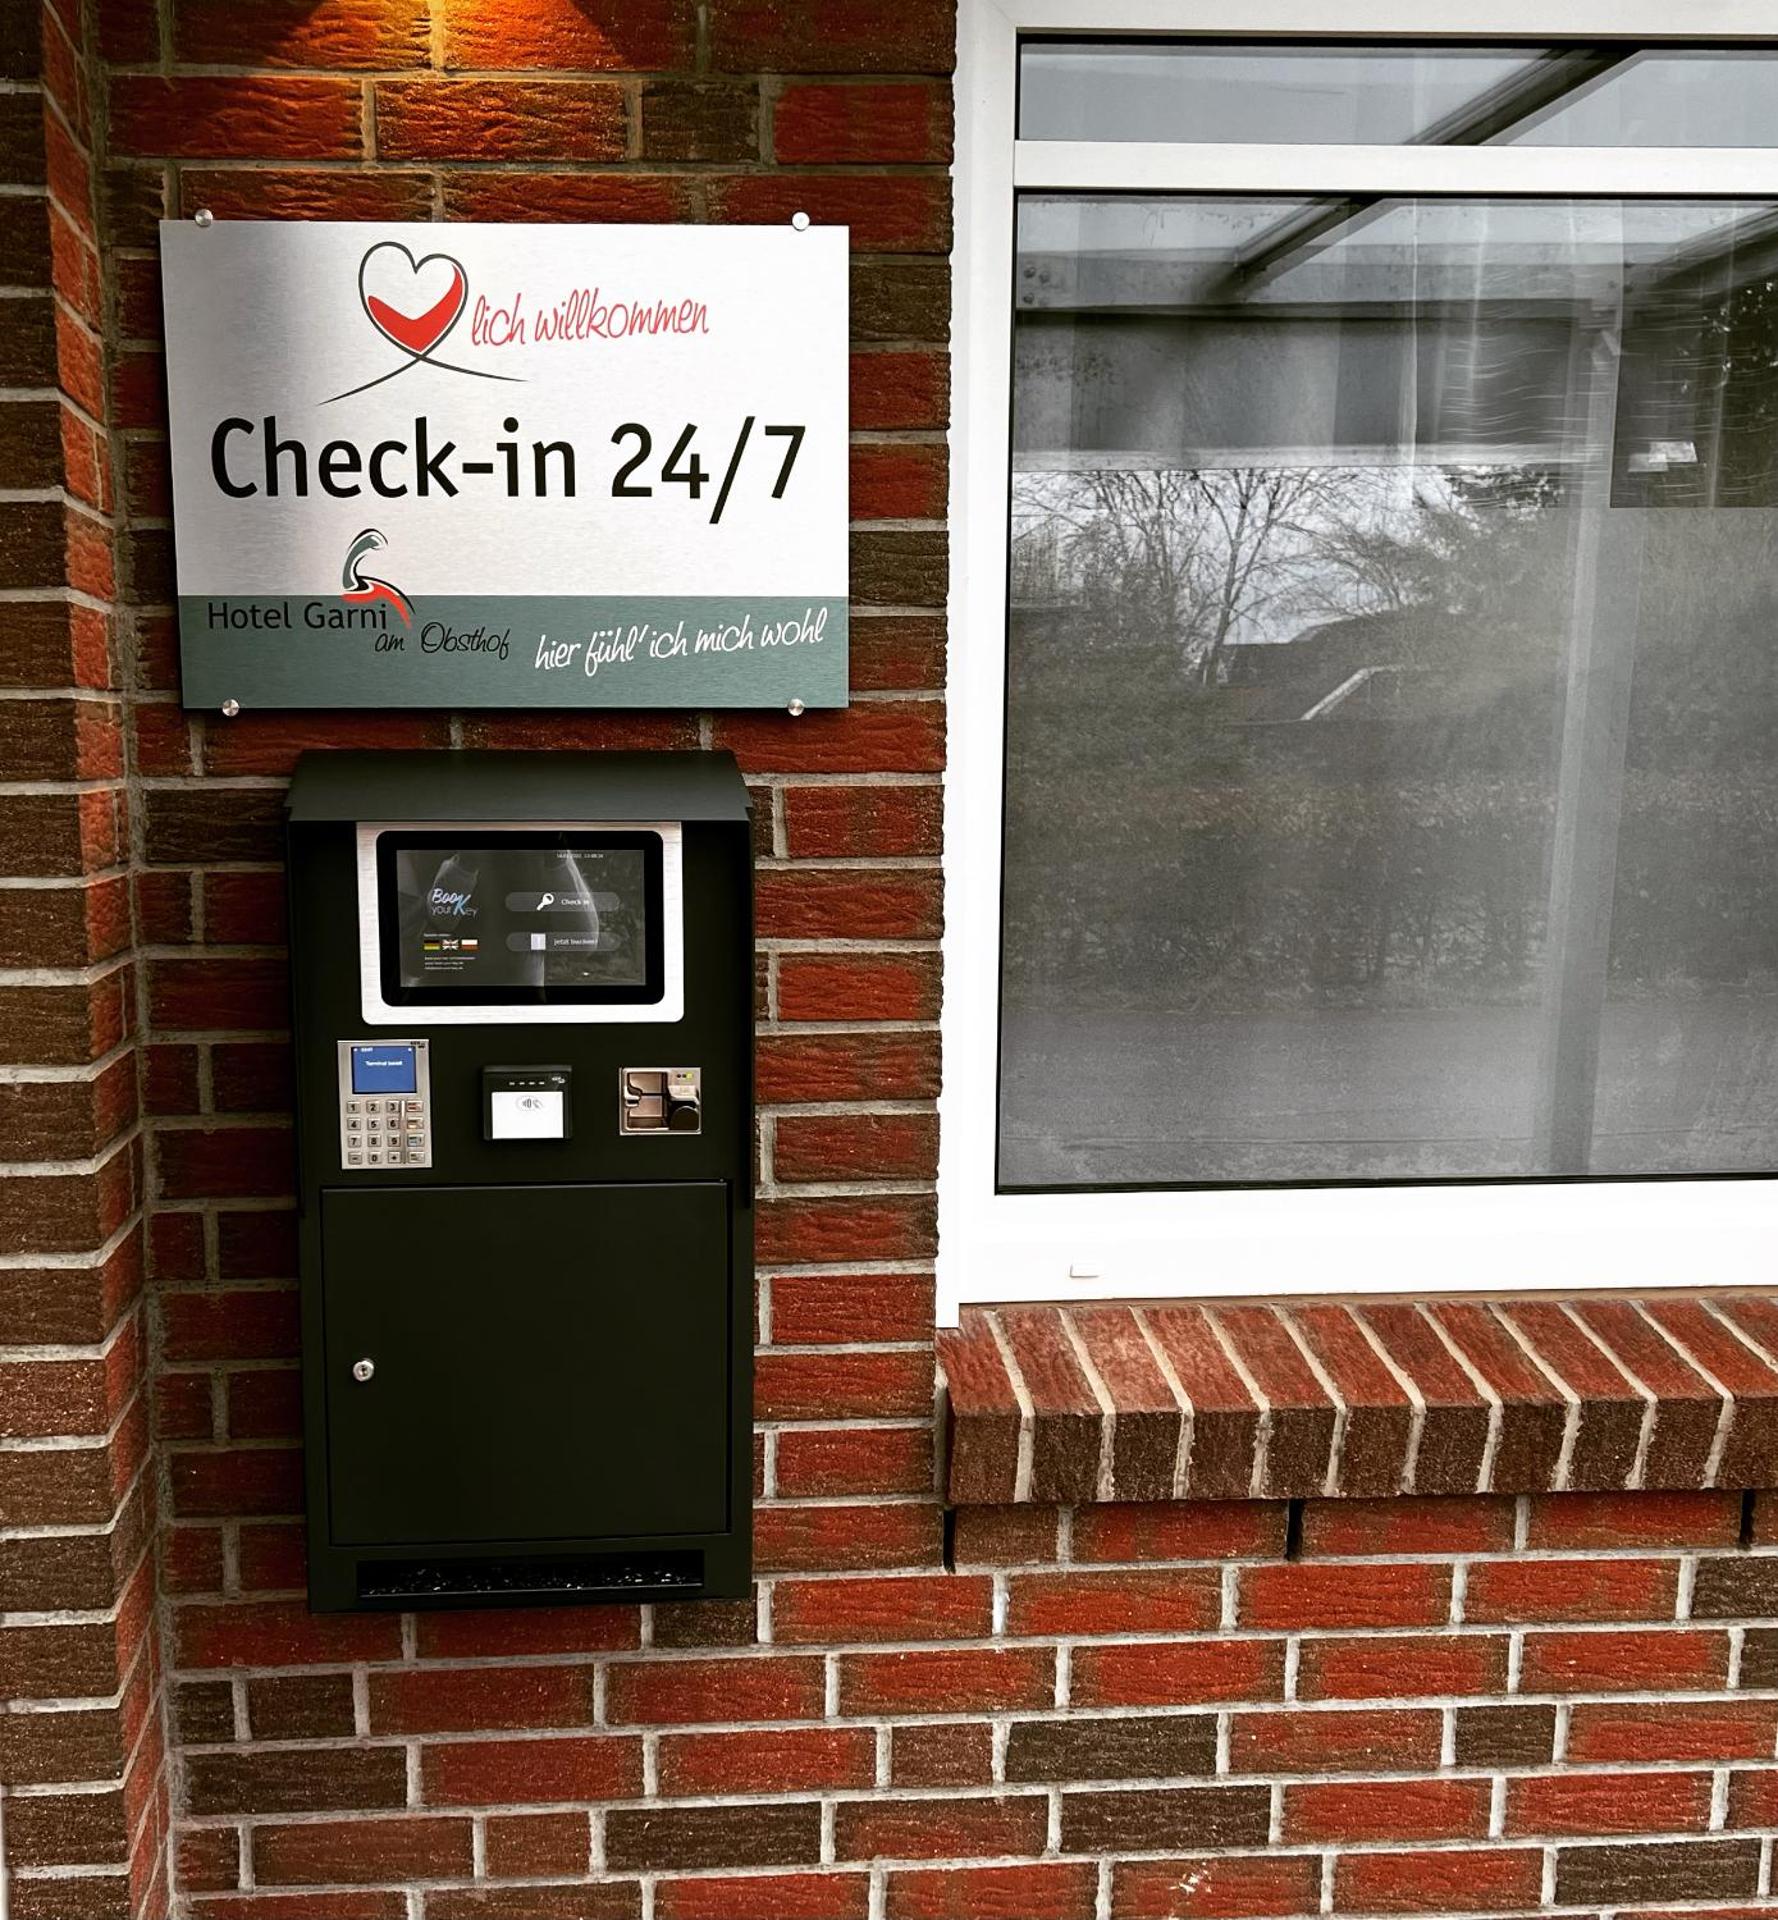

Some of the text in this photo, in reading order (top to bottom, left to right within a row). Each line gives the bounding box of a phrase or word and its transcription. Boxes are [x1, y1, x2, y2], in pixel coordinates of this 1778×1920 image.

[472, 286, 709, 347] lich willkommen
[210, 415, 807, 525] Check-in 24/7
[207, 601, 388, 630] Hotel Garni
[374, 621, 511, 661] am Obsthof
[534, 634, 582, 670] hier
[649, 620, 688, 659] ich
[695, 613, 754, 654] mich
[760, 606, 828, 648] wohl
